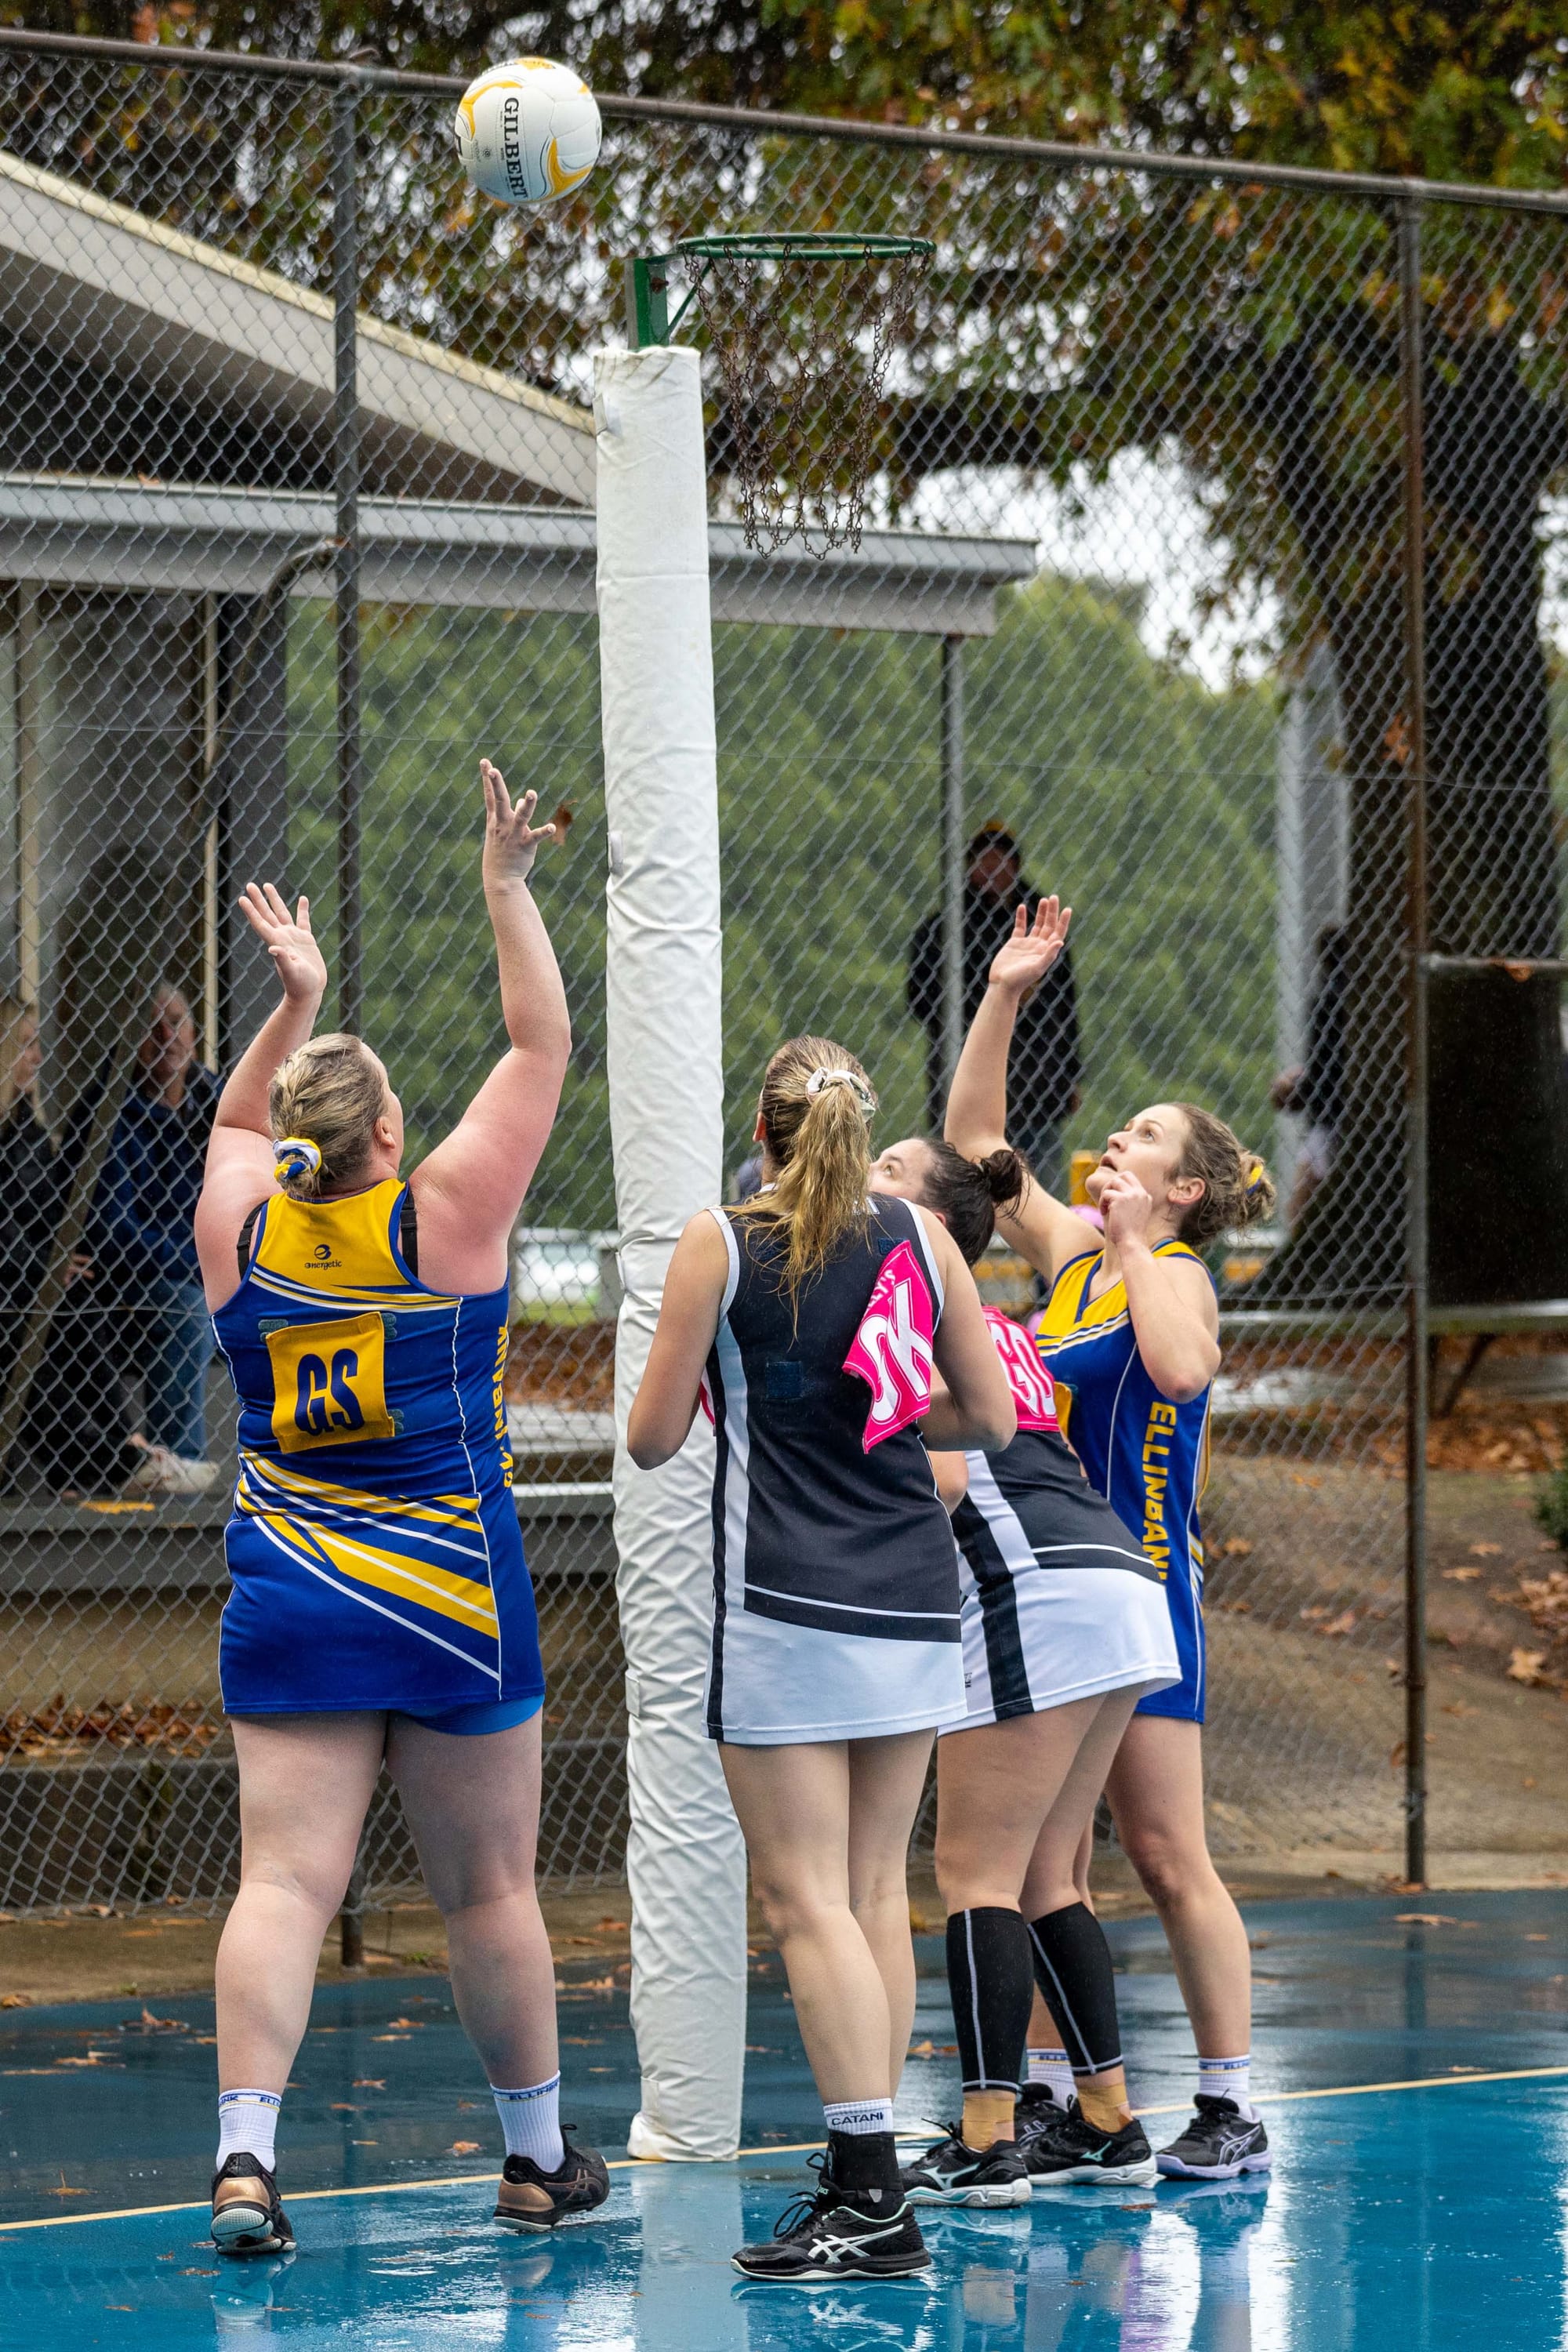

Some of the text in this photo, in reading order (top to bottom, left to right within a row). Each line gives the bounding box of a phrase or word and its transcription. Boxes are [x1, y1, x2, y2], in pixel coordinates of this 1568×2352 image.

[503, 97, 528, 198] GILBERT
[294, 1348, 365, 1436] GS
[858, 1279, 933, 1425] SK
[988, 1321, 1057, 1417] GD
[1142, 1401, 1177, 1581] ELLINBAN
[832, 2111, 884, 2125] CATANI
